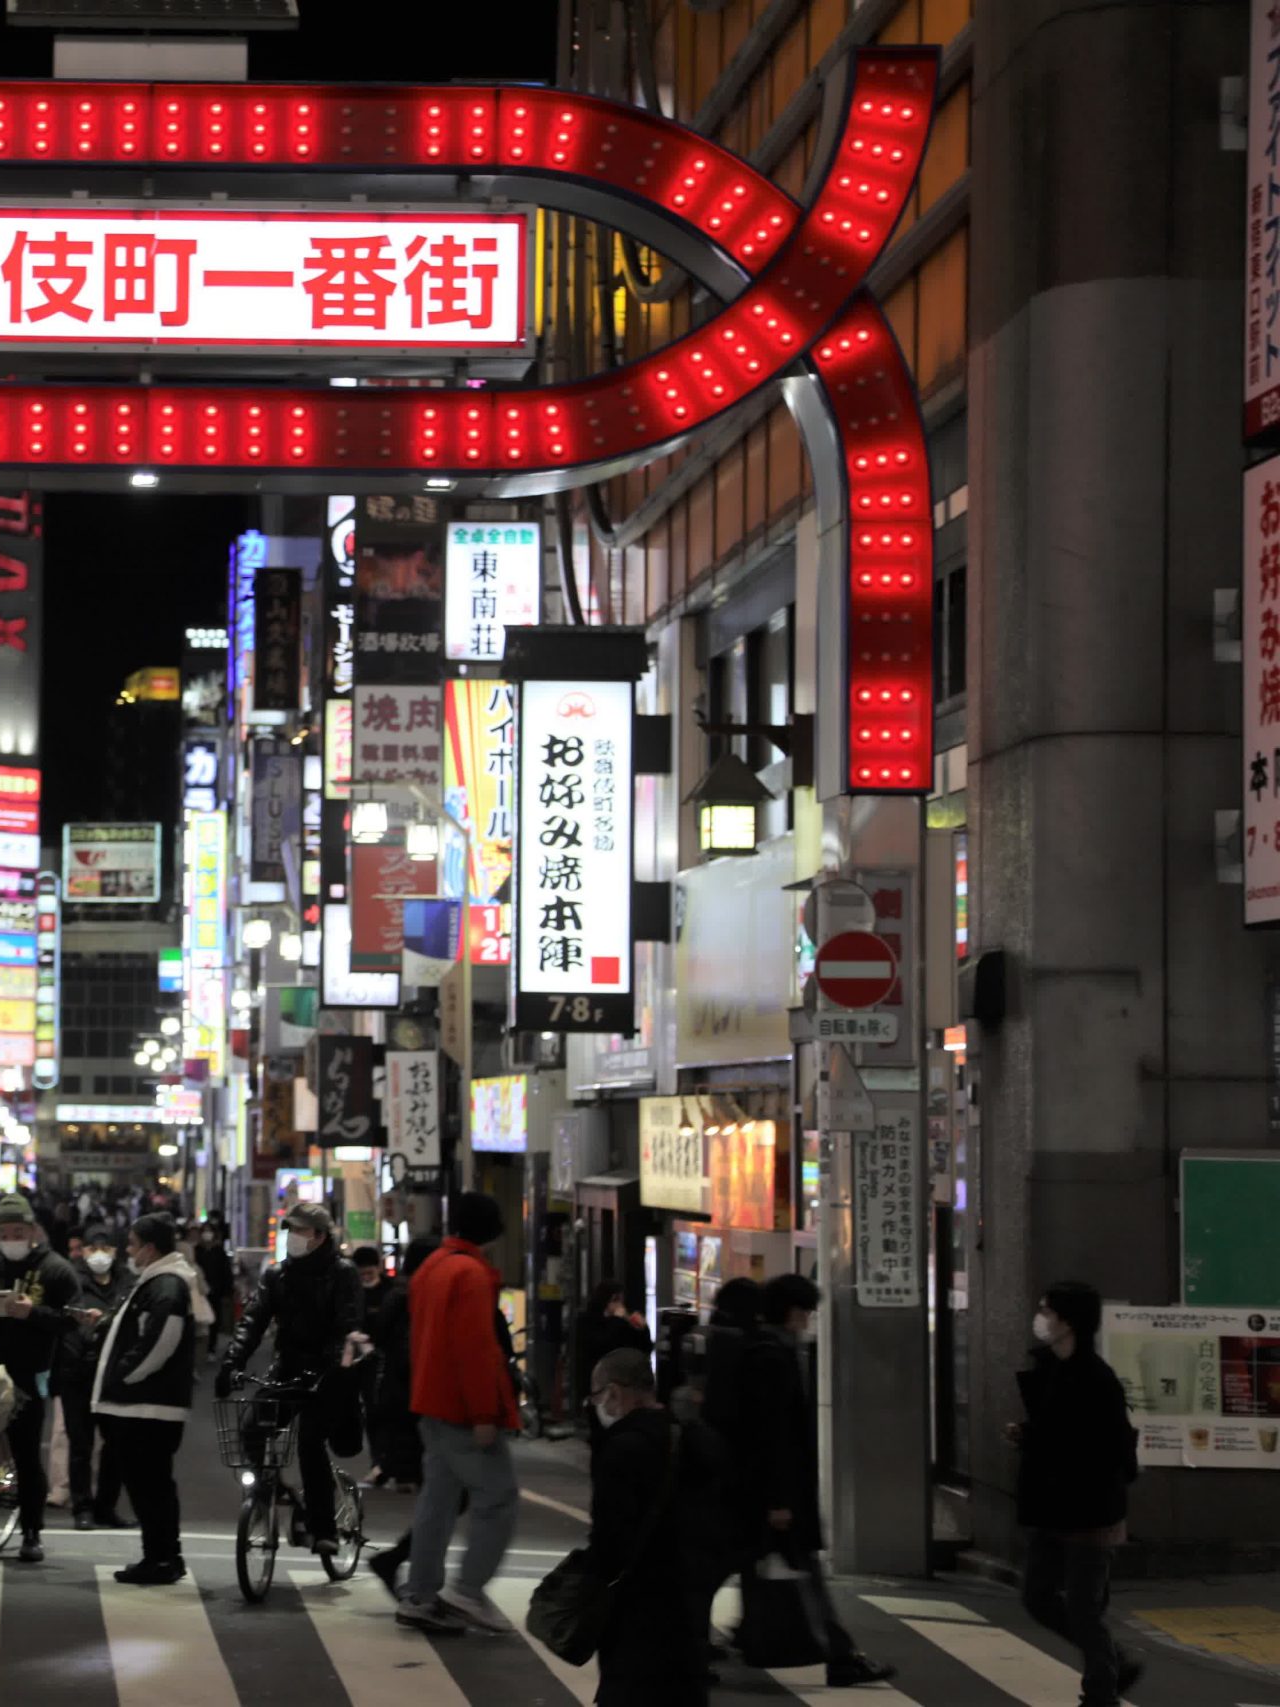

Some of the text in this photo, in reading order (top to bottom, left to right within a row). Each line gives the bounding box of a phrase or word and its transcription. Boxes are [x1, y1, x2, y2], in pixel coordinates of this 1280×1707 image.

[471, 550, 497, 655] 東南荘
[362, 694, 441, 732] 焼肉
[539, 734, 584, 972] お好み焼本陣
[820, 1019, 891, 1036] 自転車を除く
[860, 1184, 869, 1220] Camera
[880, 1125, 898, 1273] 防犯カメラ作動中
[860, 1235, 871, 1282] Operation
